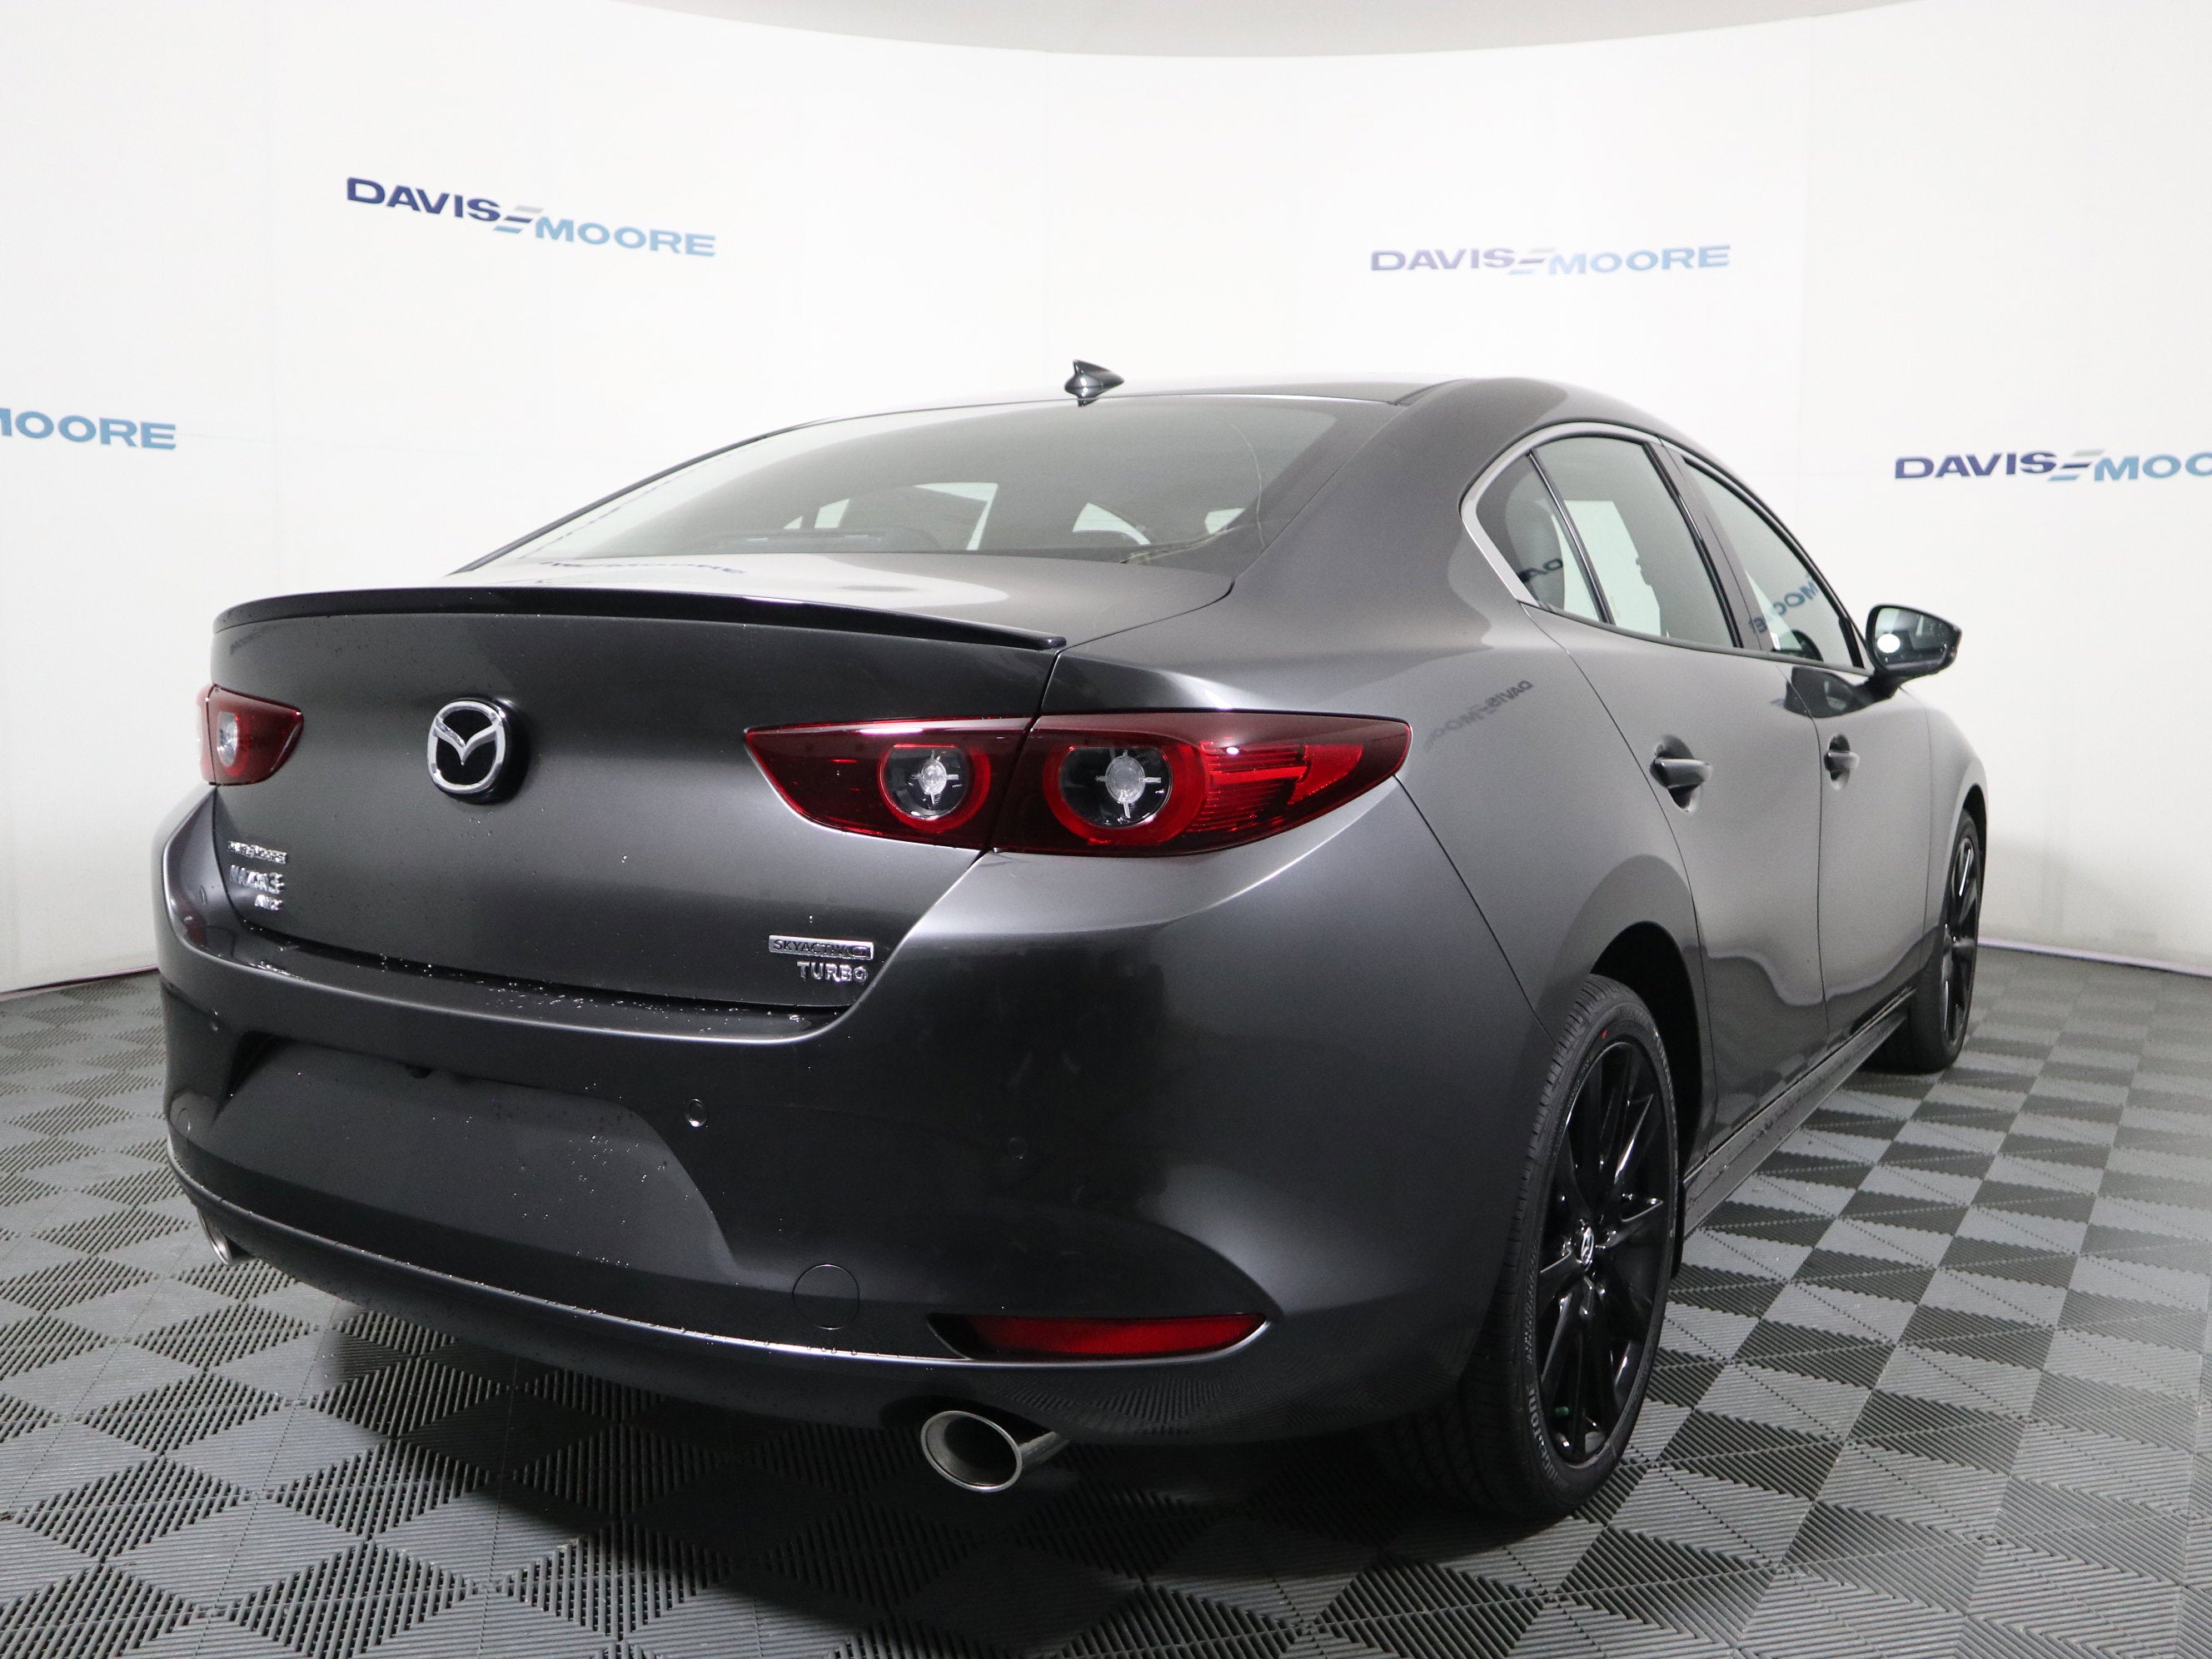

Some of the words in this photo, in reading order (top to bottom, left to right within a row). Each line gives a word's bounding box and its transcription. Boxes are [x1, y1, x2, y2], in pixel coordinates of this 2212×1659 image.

[346, 177, 501, 222] DAVIS
[535, 216, 716, 257] MOORE
[1370, 247, 1515, 272] DAVIS
[1548, 244, 1731, 275] MOORE
[1895, 451, 2057, 480] DAVIS
[797, 960, 869, 983] TURBO
